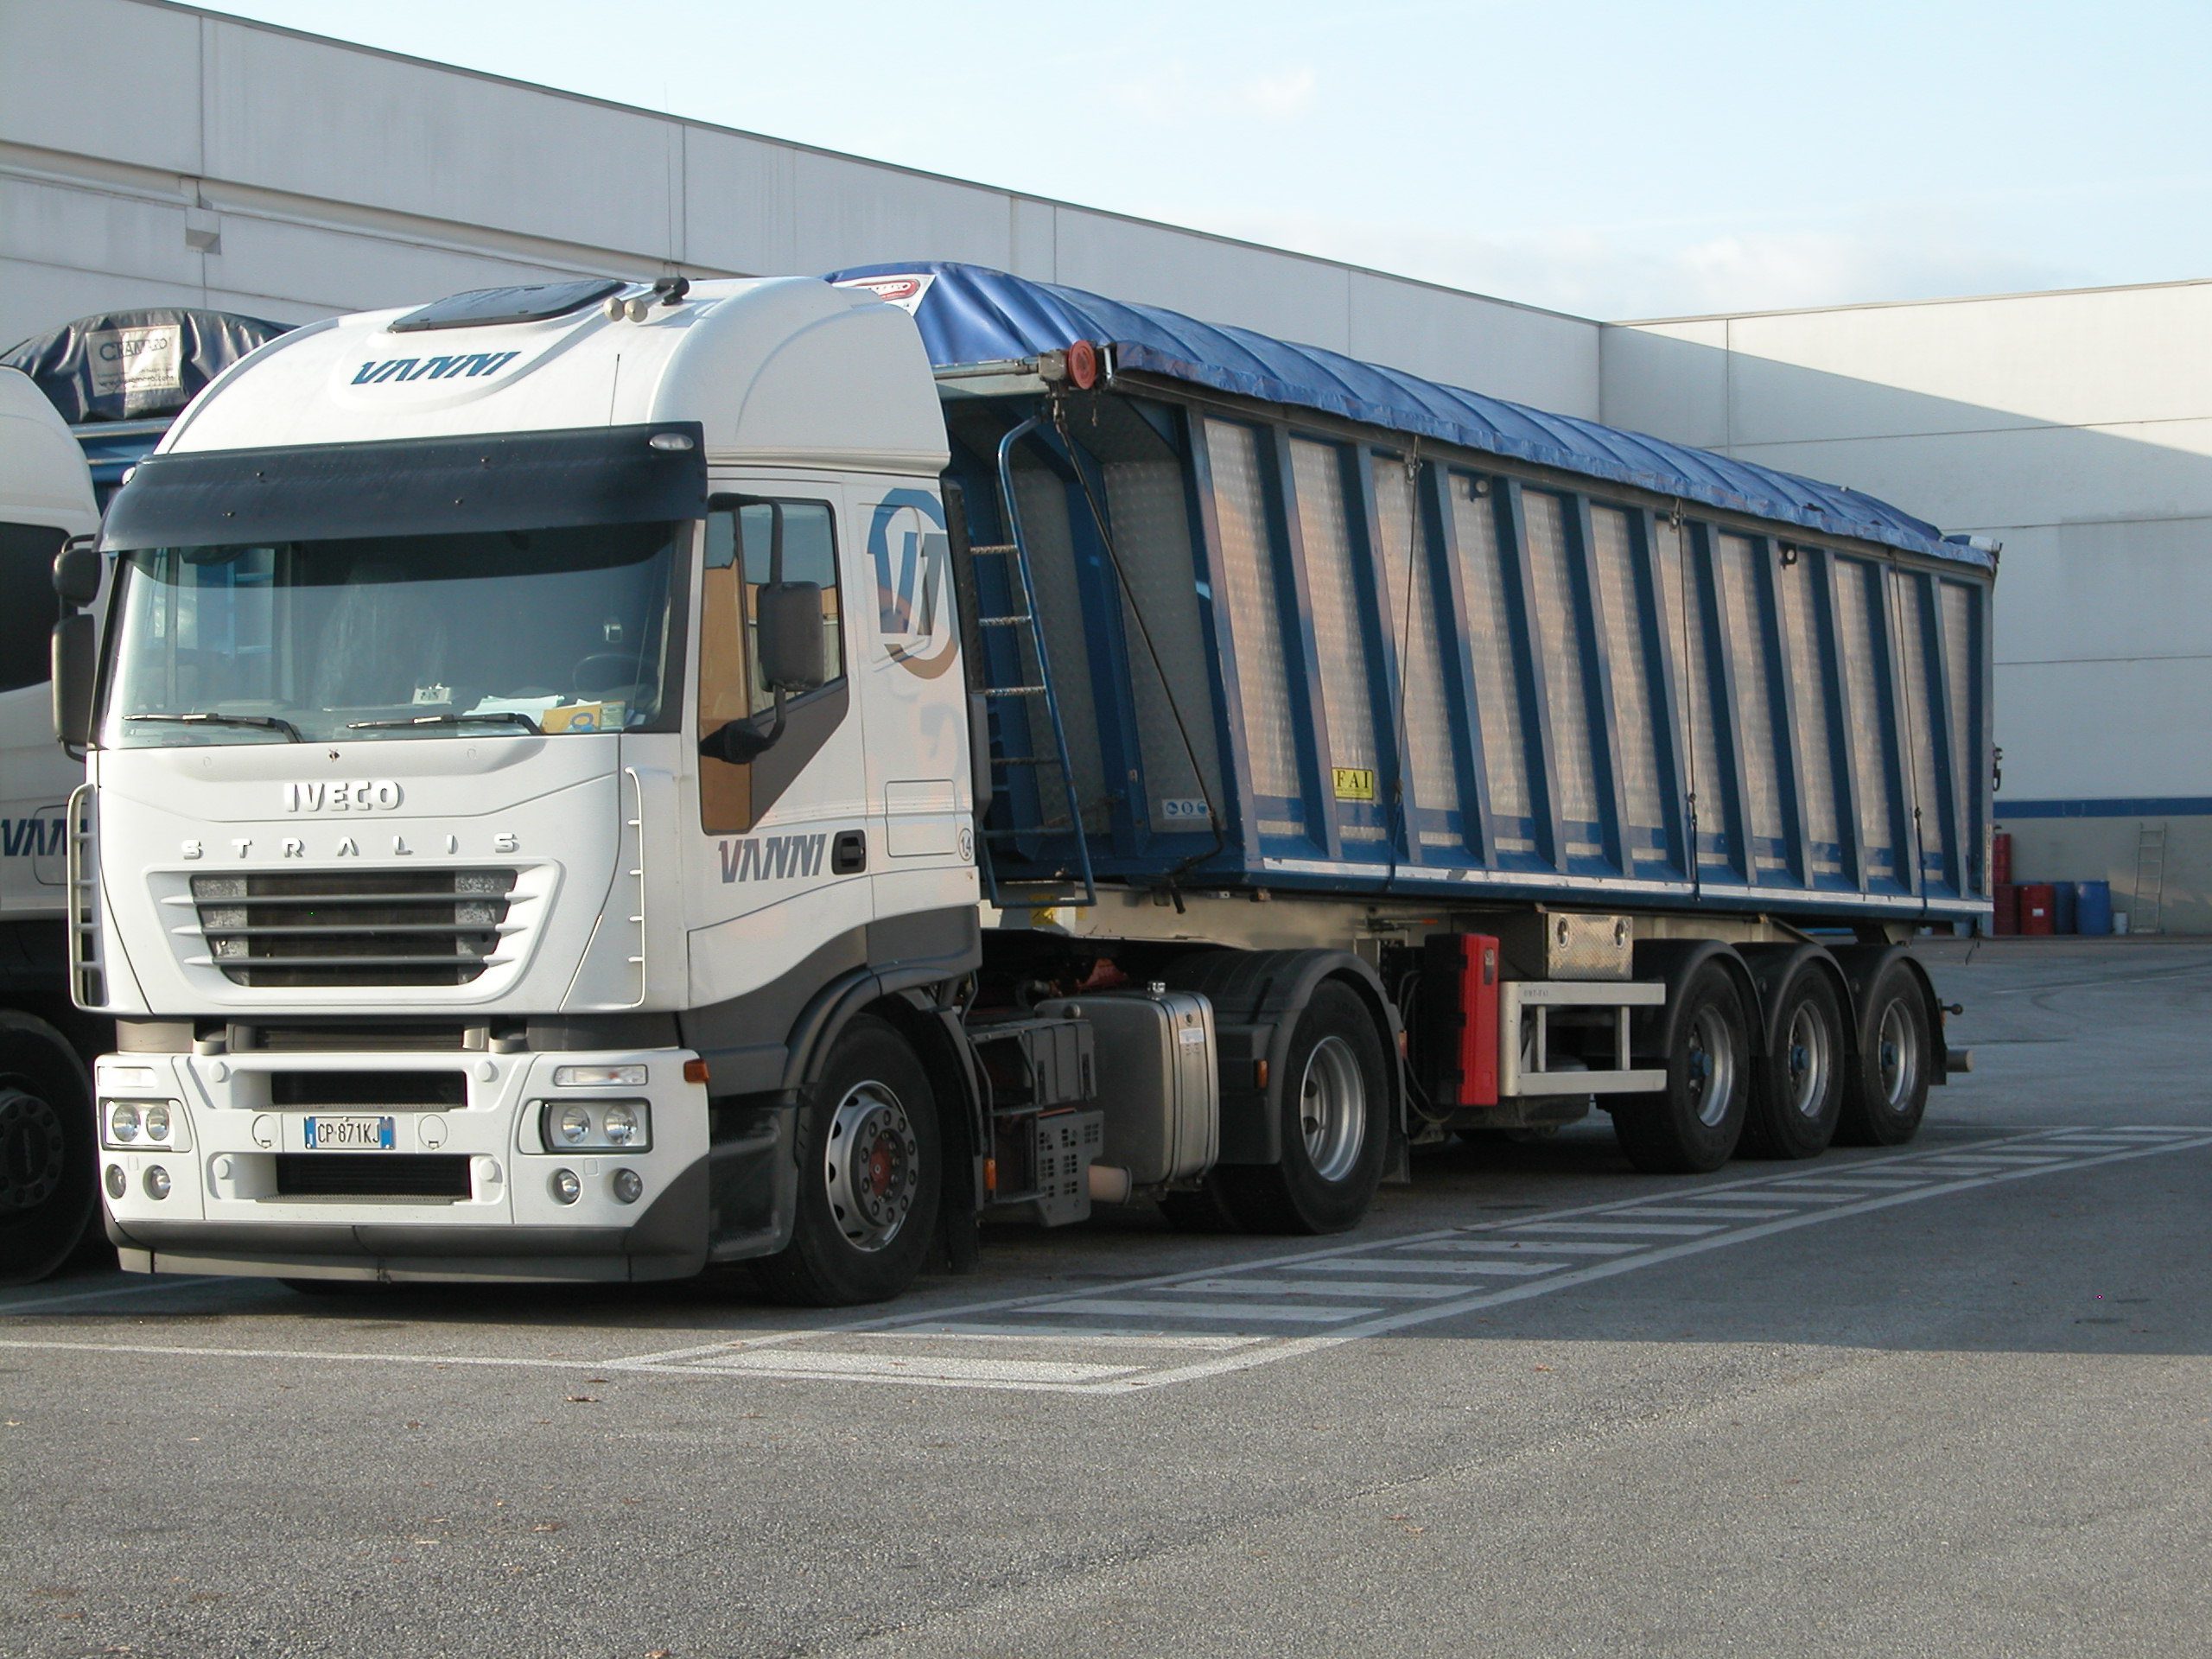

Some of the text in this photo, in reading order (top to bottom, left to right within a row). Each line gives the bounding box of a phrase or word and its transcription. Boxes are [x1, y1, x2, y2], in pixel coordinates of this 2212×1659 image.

[351, 351, 522, 385] VANNI
[283, 779, 403, 812] IVECO
[1336, 769, 1370, 789] FAI
[180, 832, 519, 860] STRALIS
[718, 833, 827, 884] VANNI
